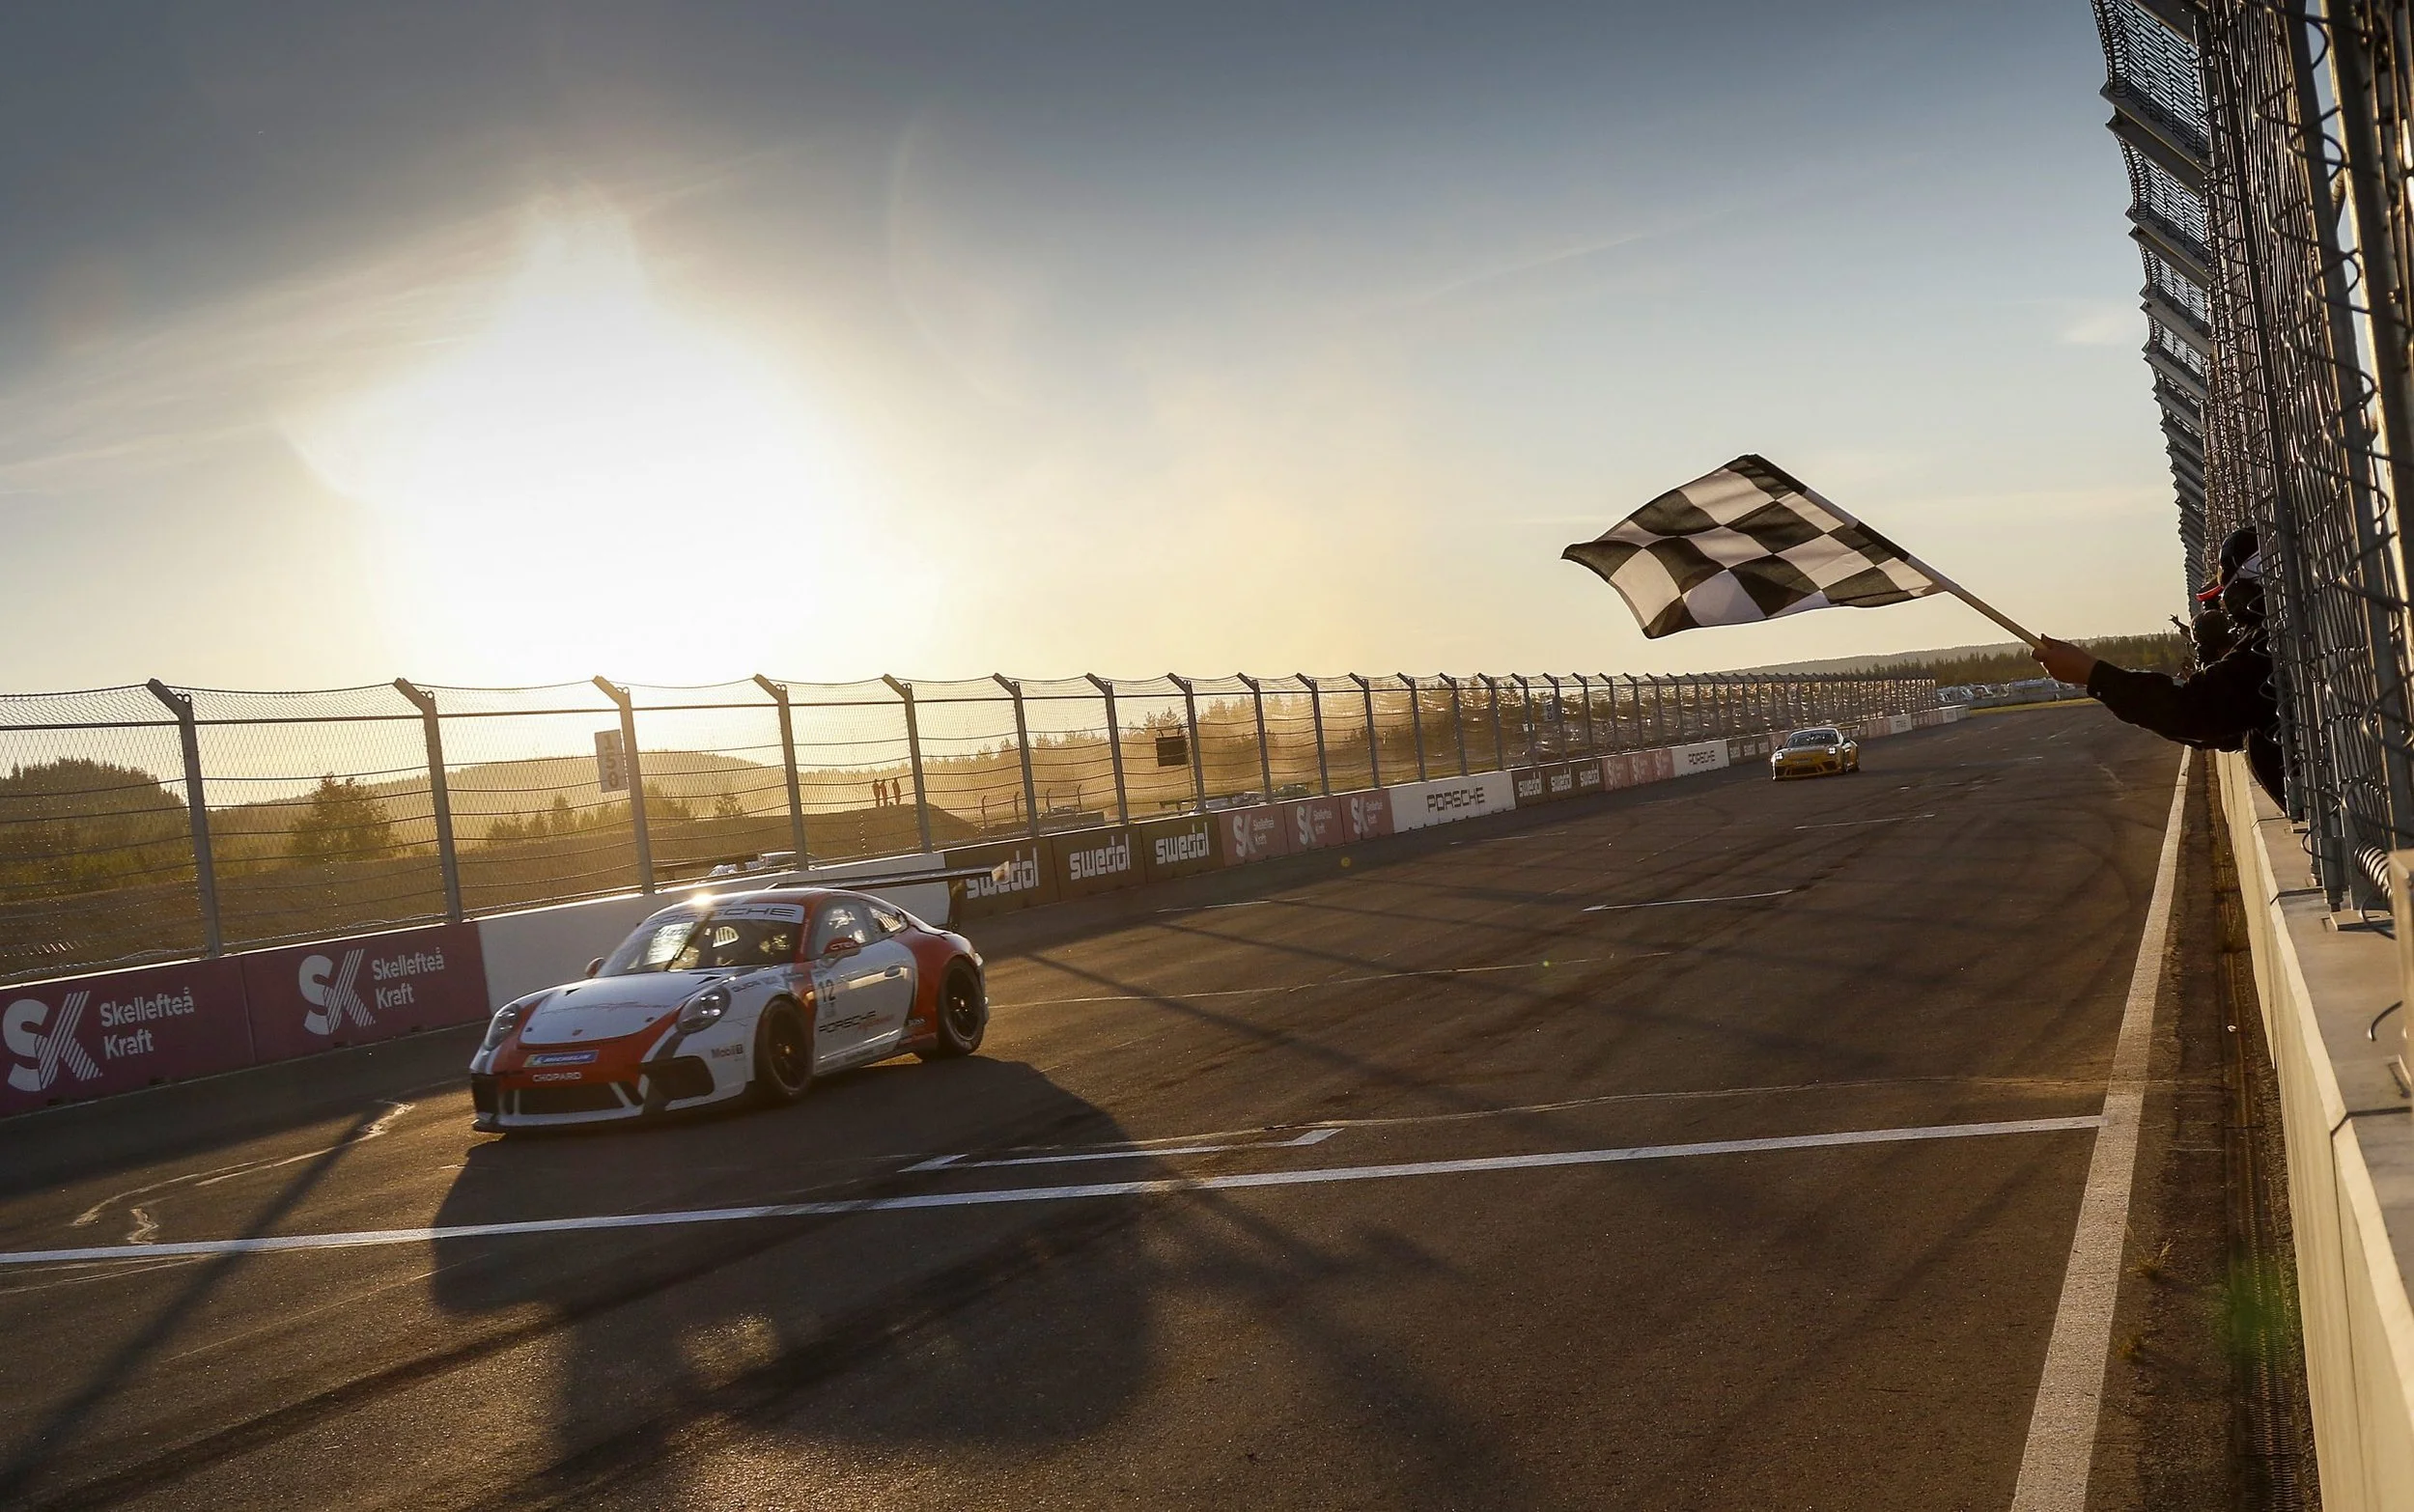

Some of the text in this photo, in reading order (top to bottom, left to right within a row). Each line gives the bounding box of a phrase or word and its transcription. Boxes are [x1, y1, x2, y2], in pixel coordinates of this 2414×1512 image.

[1427, 787, 1485, 812] PORSCHE
[1069, 834, 1131, 881] swedol
[1156, 822, 1210, 864] swedol
[967, 847, 1039, 899] swdol
[372, 946, 444, 981] Skellefteå
[99, 986, 194, 1027] Skellefteå
[298, 948, 376, 1035] SK
[376, 983, 414, 1009] Kraft
[818, 978, 836, 1002] 12
[3, 990, 103, 1092] SK
[103, 1028, 154, 1059] Kraft
